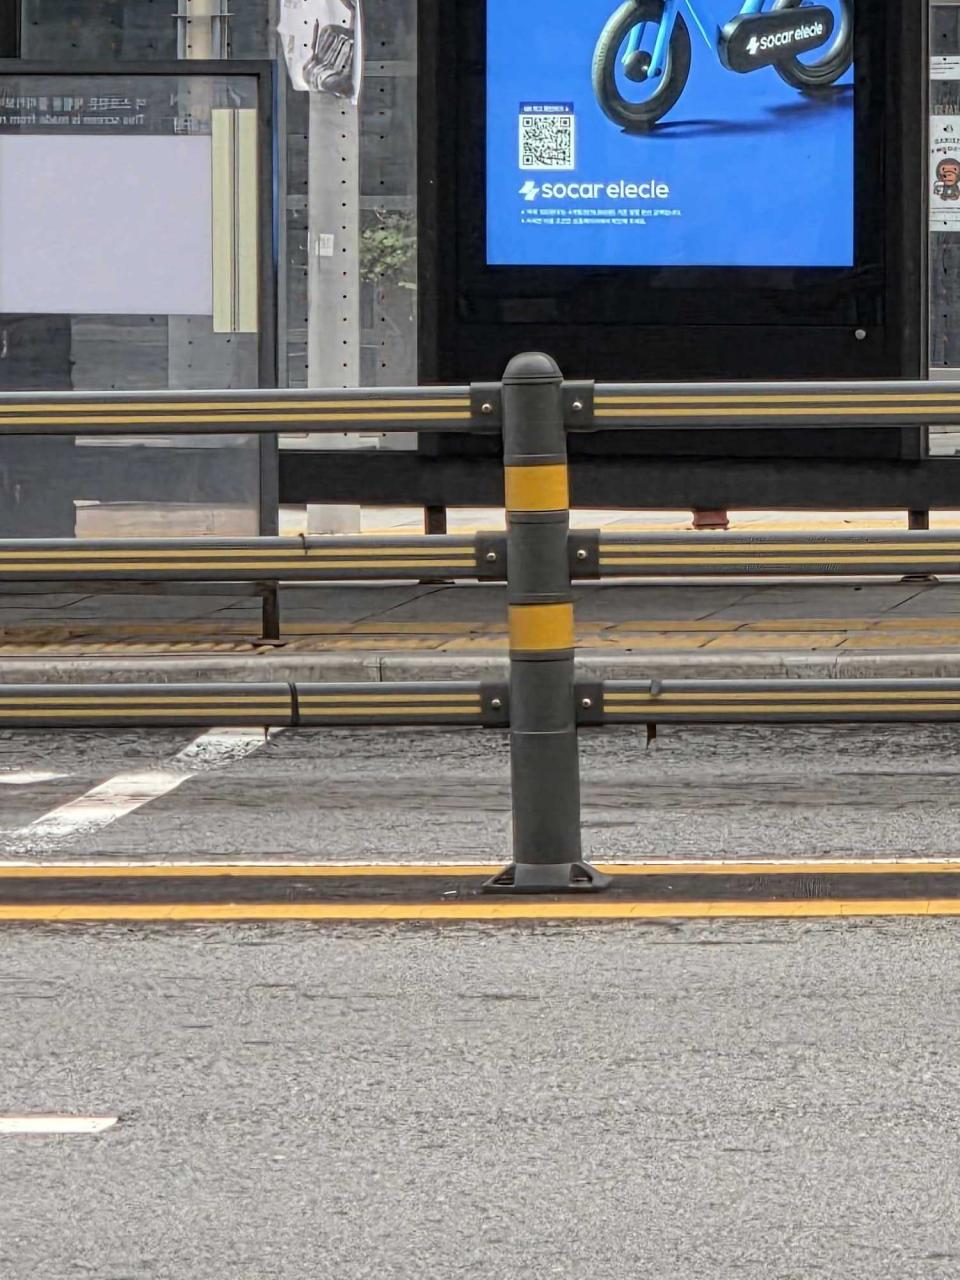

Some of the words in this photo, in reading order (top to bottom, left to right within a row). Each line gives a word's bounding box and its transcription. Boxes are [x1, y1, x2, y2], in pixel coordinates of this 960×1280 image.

[760, 30, 794, 50] socar
[542, 183, 603, 198] socar
[606, 180, 669, 199] elecle
